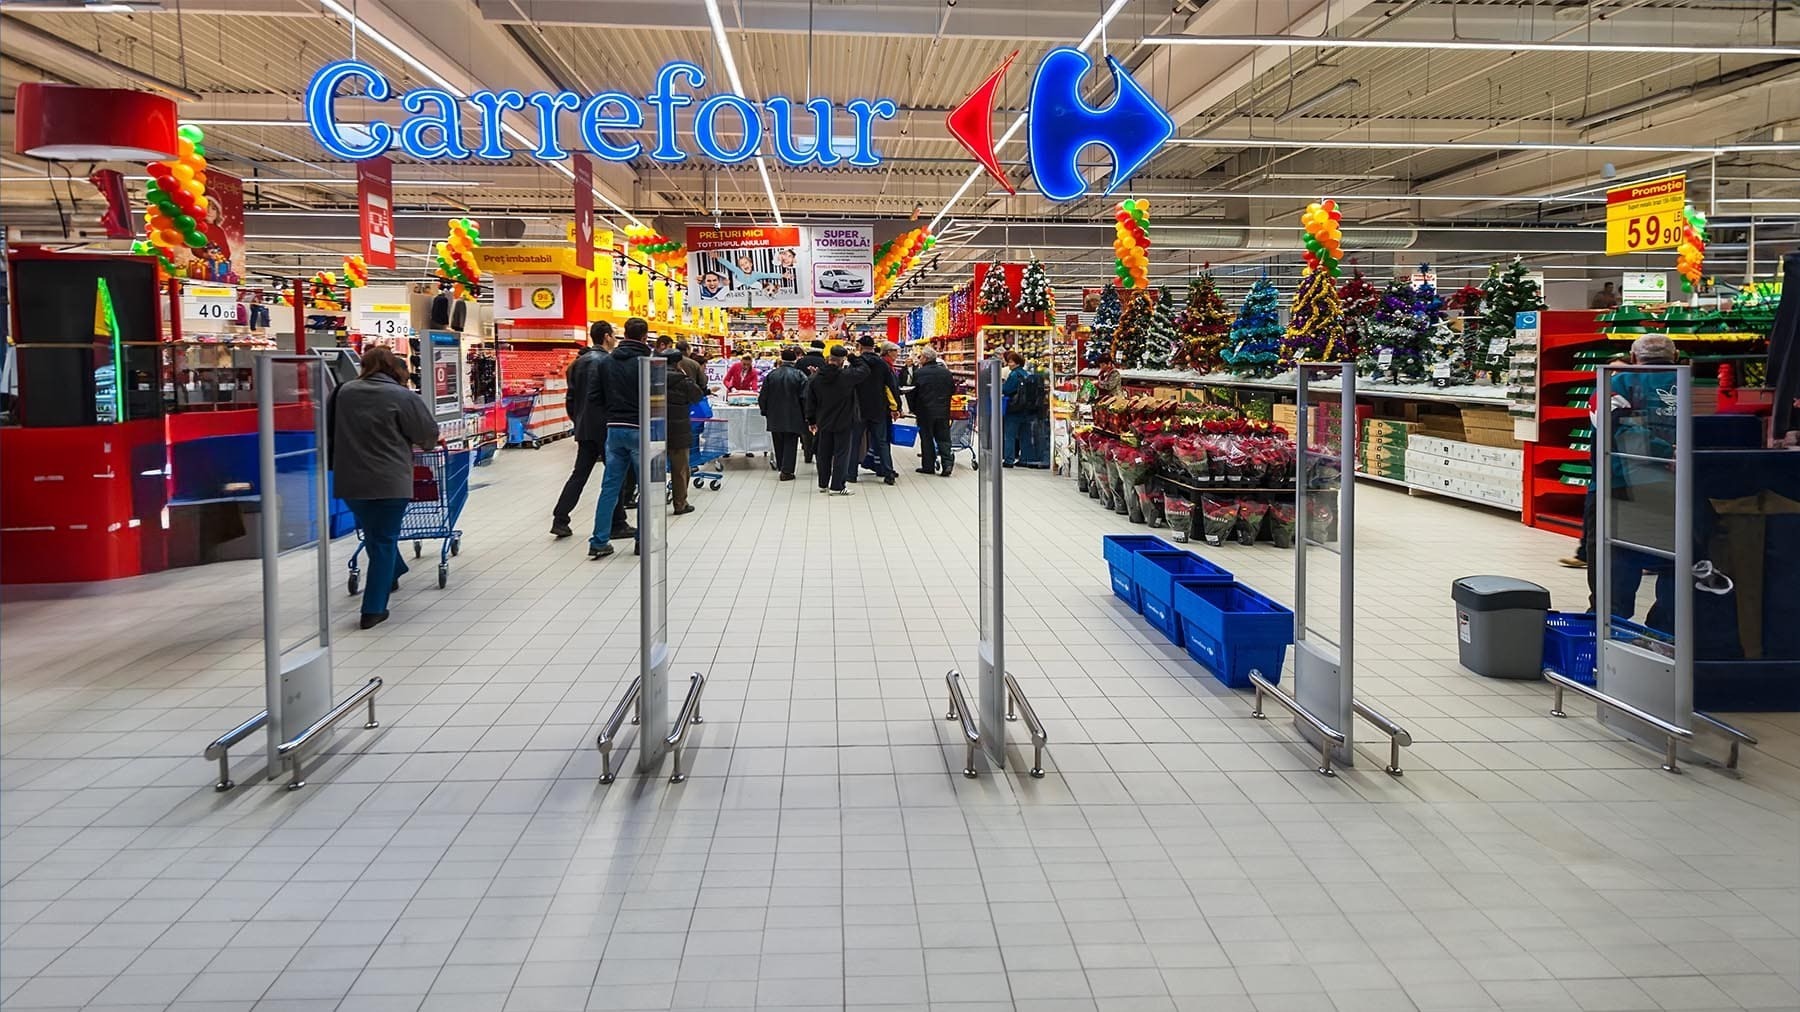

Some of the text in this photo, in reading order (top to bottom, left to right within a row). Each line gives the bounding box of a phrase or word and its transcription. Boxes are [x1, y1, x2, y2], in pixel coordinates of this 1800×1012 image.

[306, 60, 896, 166] Carrefour
[742, 229, 764, 238] MICI
[824, 230, 859, 239] SUPER
[1627, 215, 1681, 249] 59 90
[815, 236, 871, 248] TOMBOLĂ!
[506, 254, 552, 263] imbatabil
[590, 277, 599, 308] 1
[600, 294, 612, 309] 15
[199, 304, 236, 318] 40 00
[635, 305, 648, 318] 45
[656, 311, 667, 322] 59
[375, 320, 409, 334] 13 00
[1437, 378, 1446, 387] 3
